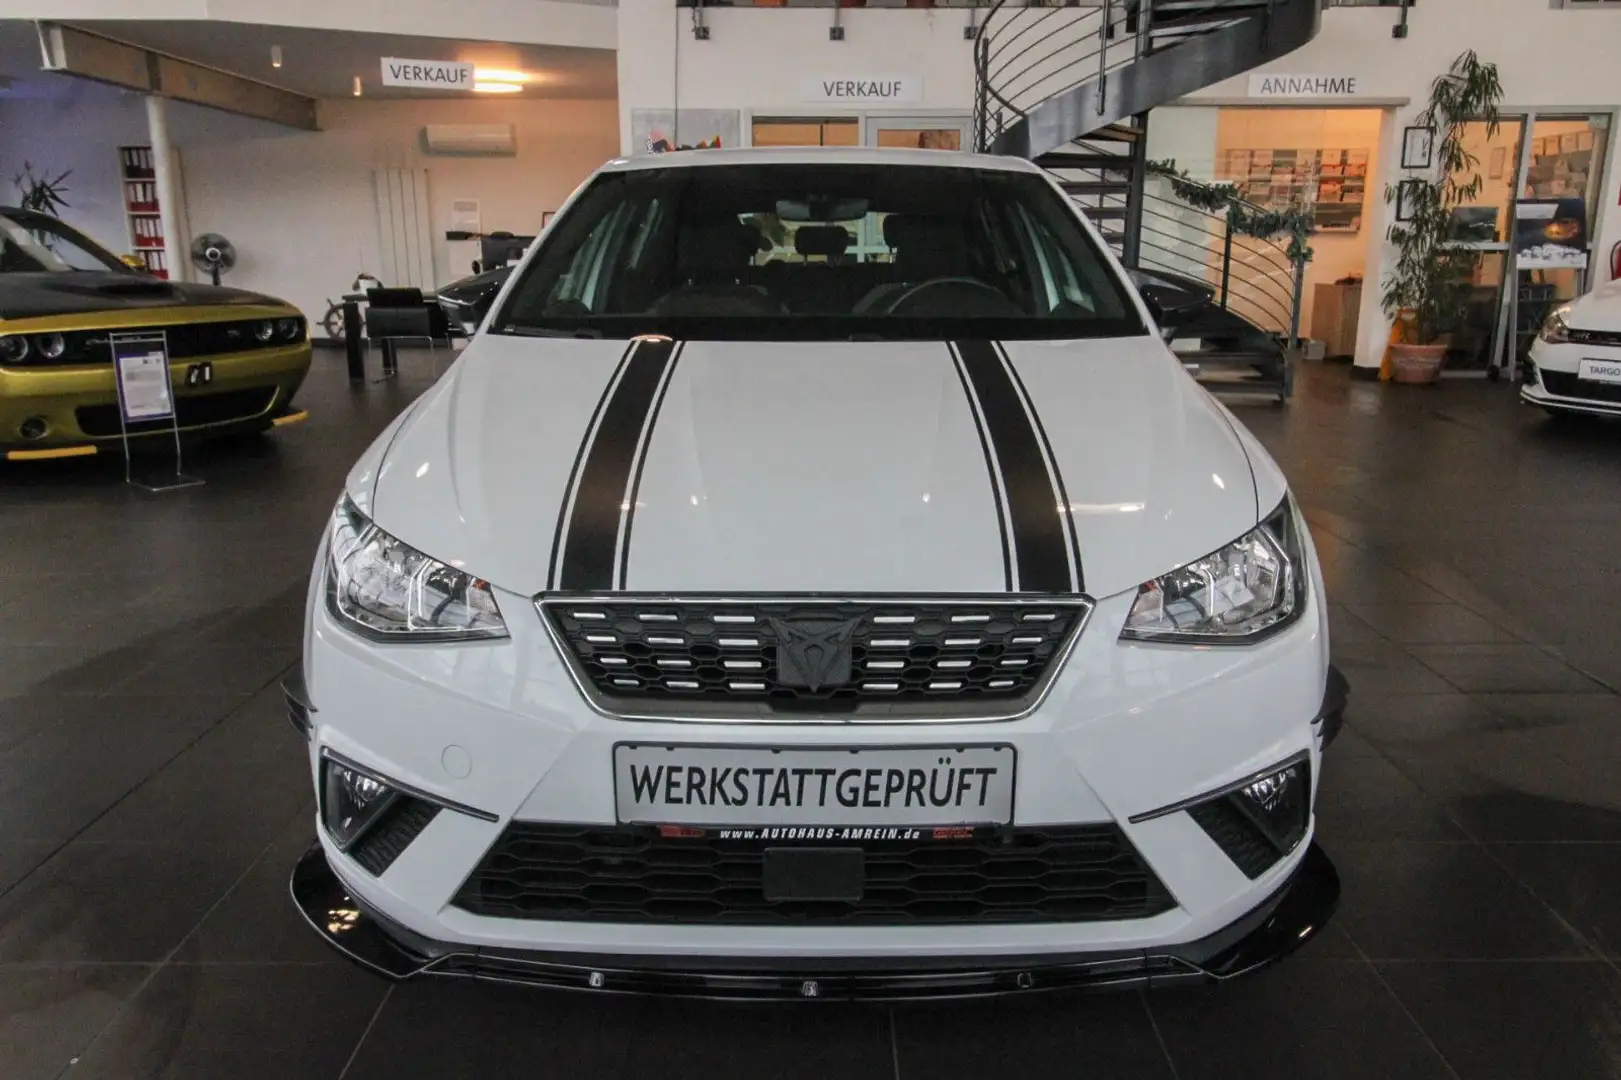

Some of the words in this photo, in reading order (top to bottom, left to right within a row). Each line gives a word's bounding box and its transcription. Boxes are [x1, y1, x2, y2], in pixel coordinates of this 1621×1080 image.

[389, 64, 469, 83] VERKAUF
[823, 80, 902, 97] VERKAUF
[1260, 77, 1357, 94] ANNAHME
[630, 757, 998, 808] WERKSTATTGEPRÜFT
[719, 827, 921, 840] www.AUTOHAUS-AMREIN.de
